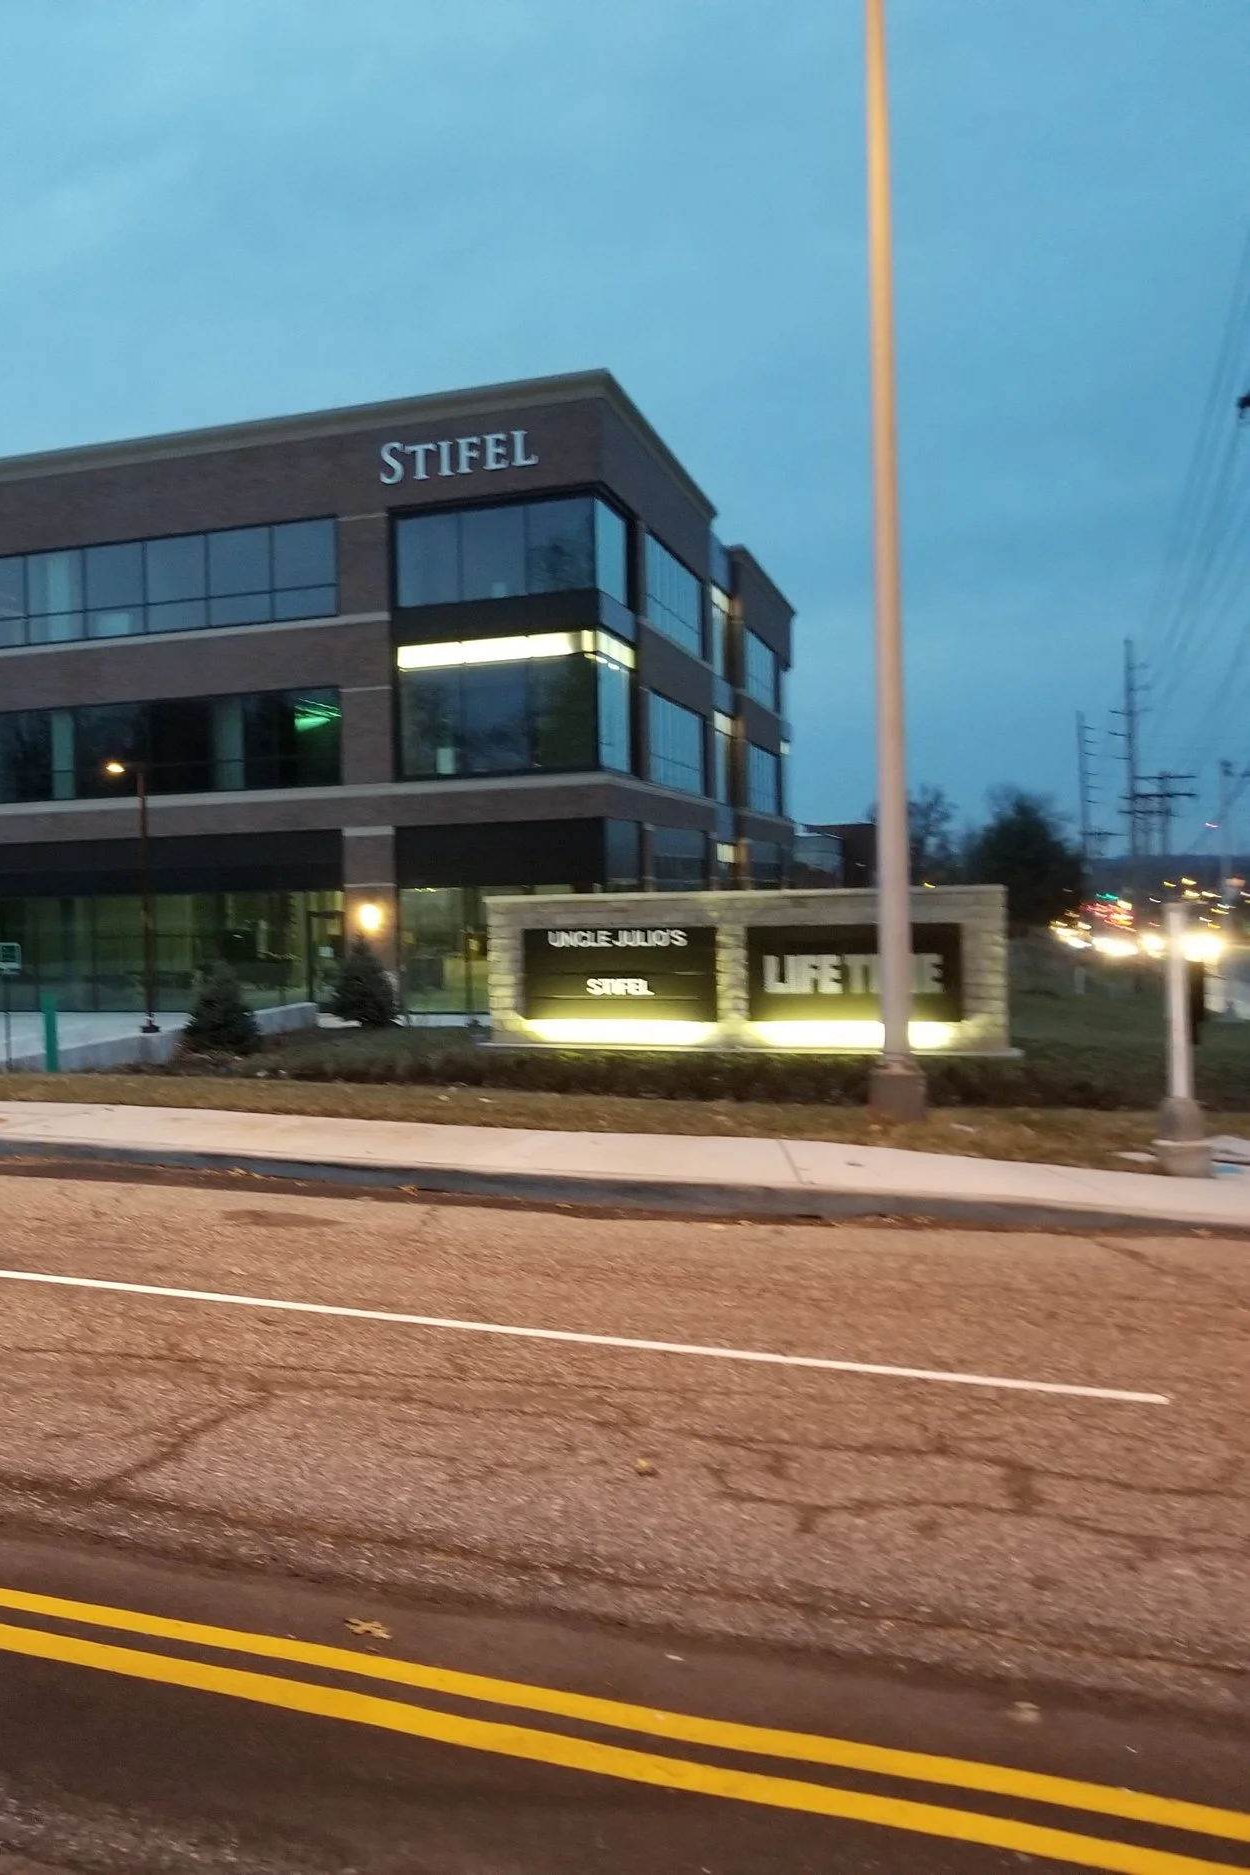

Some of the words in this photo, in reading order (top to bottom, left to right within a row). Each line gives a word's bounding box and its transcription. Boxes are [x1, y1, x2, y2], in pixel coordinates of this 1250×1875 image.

[380, 430, 539, 485] STIFEL
[548, 930, 613, 948] UNCLE
[612, 928, 688, 947] JULIO'S
[586, 978, 655, 996] STIFEL
[763, 953, 843, 994] LIFE
